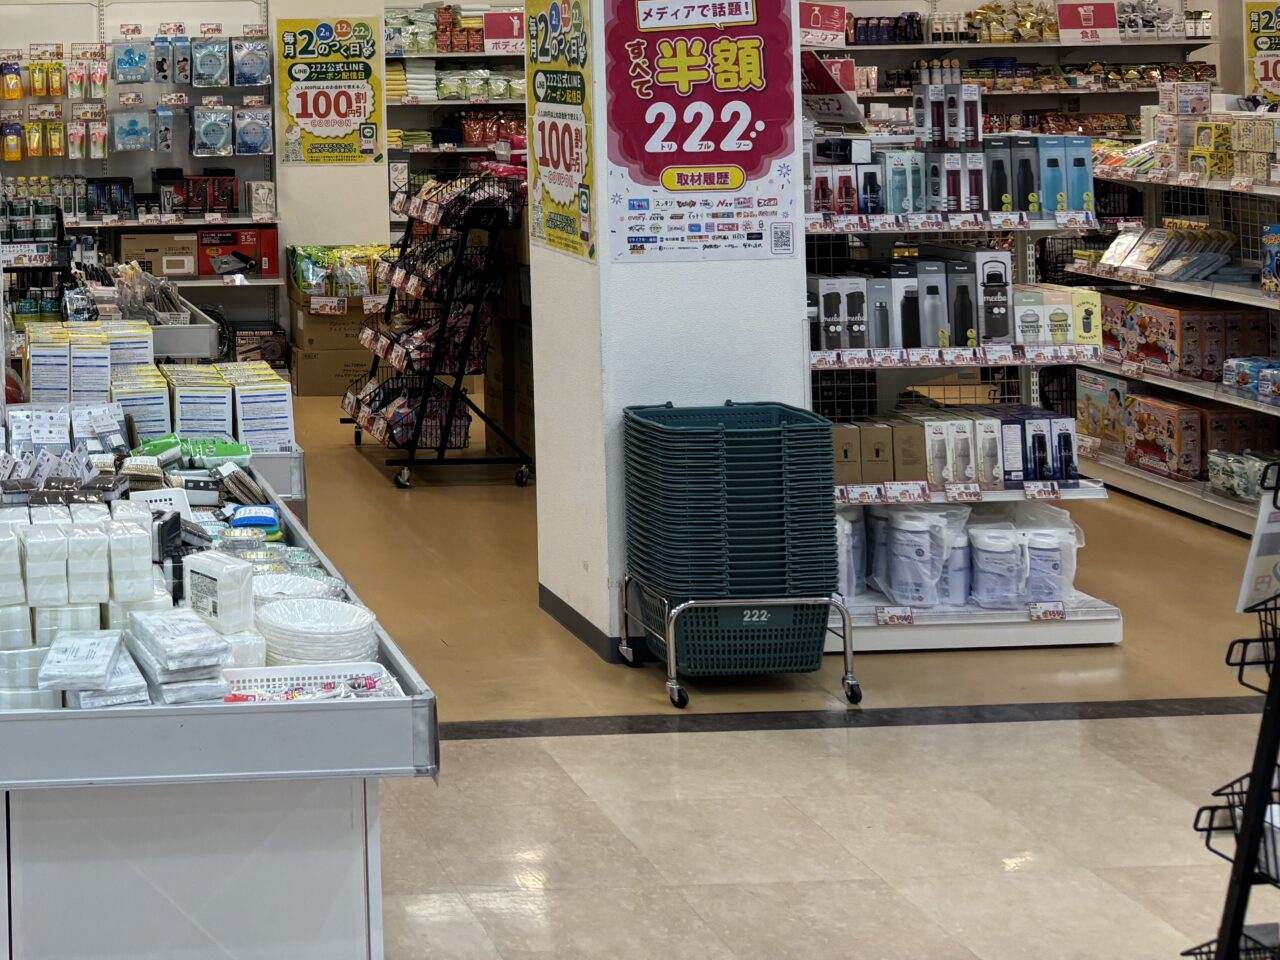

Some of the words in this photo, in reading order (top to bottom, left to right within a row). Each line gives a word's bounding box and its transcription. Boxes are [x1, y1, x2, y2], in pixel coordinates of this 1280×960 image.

[642, 1, 750, 22] メディアで話題!
[1080, 30, 1099, 39] 食品
[282, 32, 297, 59] 毎月
[311, 63, 365, 72] 222公式LINE
[625, 38, 654, 99] すべて
[655, 36, 766, 97] 半額
[311, 72, 365, 80] クーポン配信日
[536, 81, 545, 89] LINE
[546, 74, 582, 88] 222公式LINE
[311, 119, 352, 128] COUPON
[644, 100, 753, 153] 222
[548, 170, 574, 188] COUPON
[676, 171, 730, 187] 取材履歴
[27, 254, 52, 263] ¥498
[743, 610, 768, 622] 222
